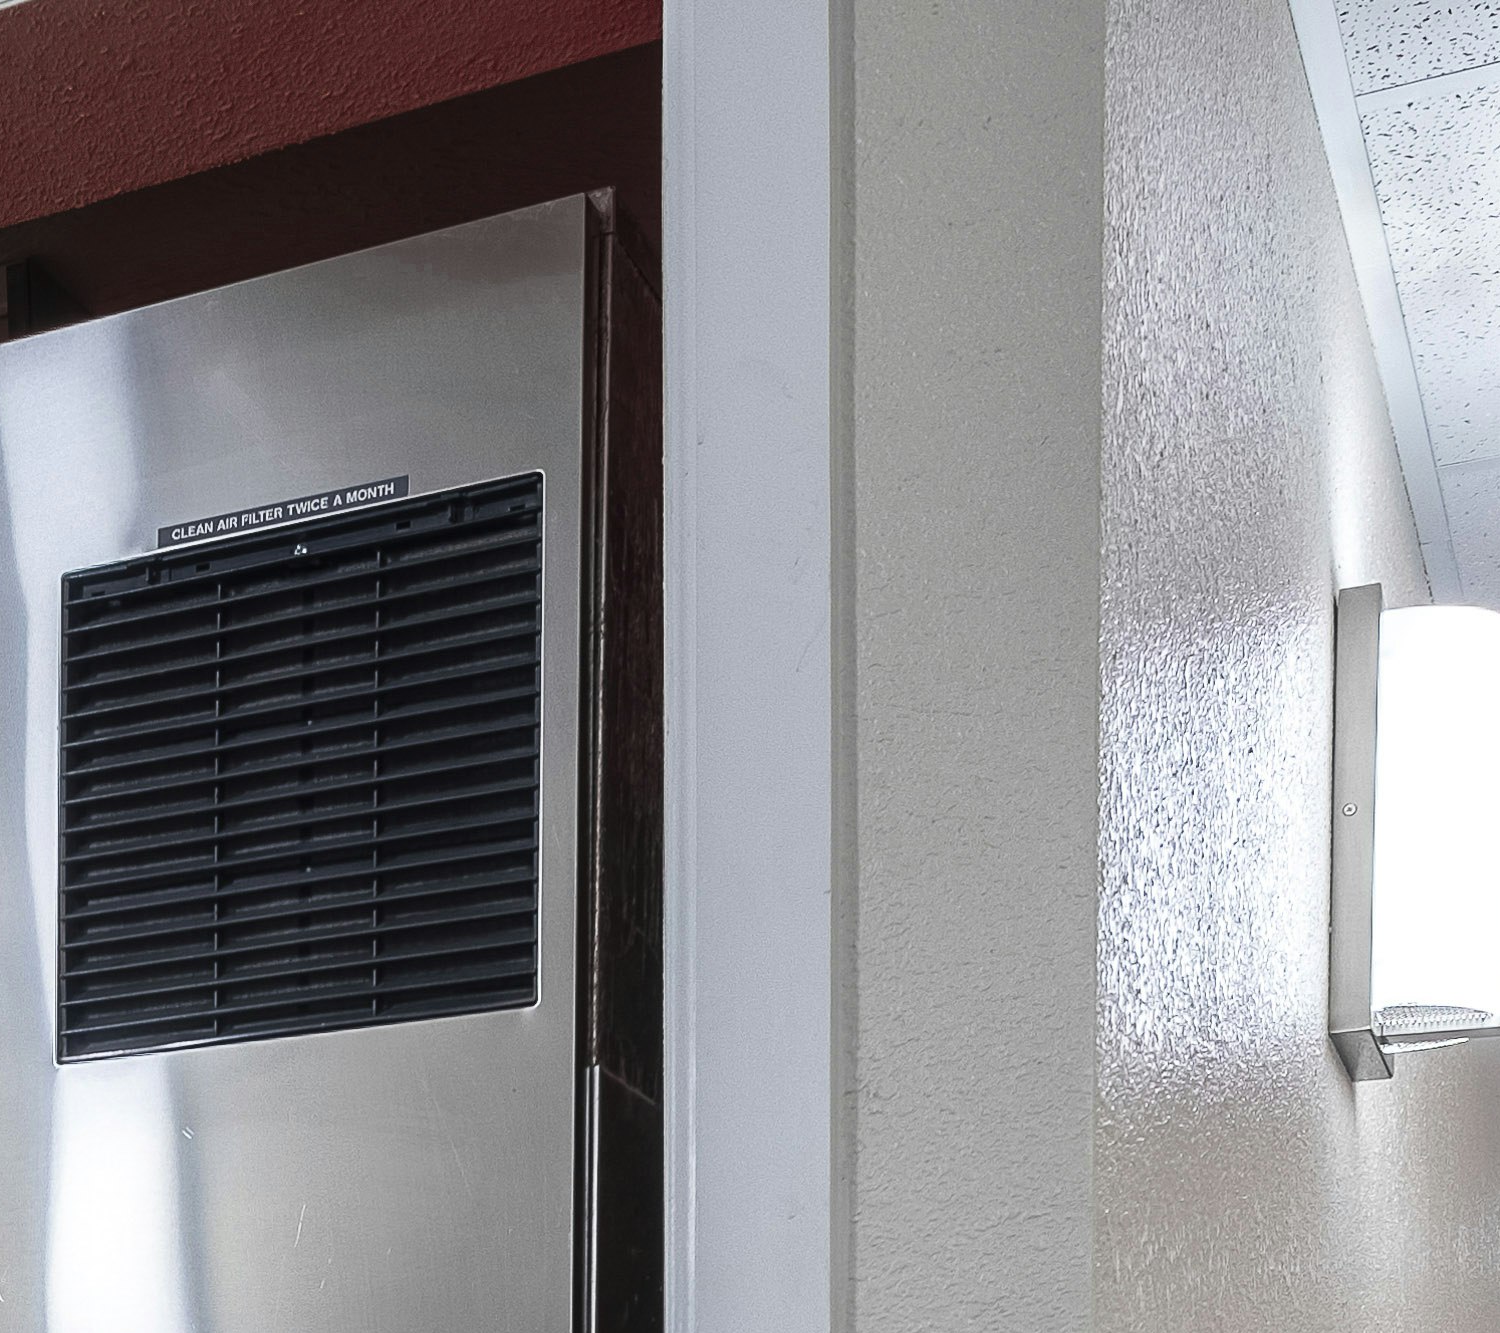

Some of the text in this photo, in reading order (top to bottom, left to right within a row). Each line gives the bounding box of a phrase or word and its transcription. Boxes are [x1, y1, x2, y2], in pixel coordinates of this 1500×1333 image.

[171, 482, 394, 541] CLEAN AIR FILTER TWICE A MONTH
